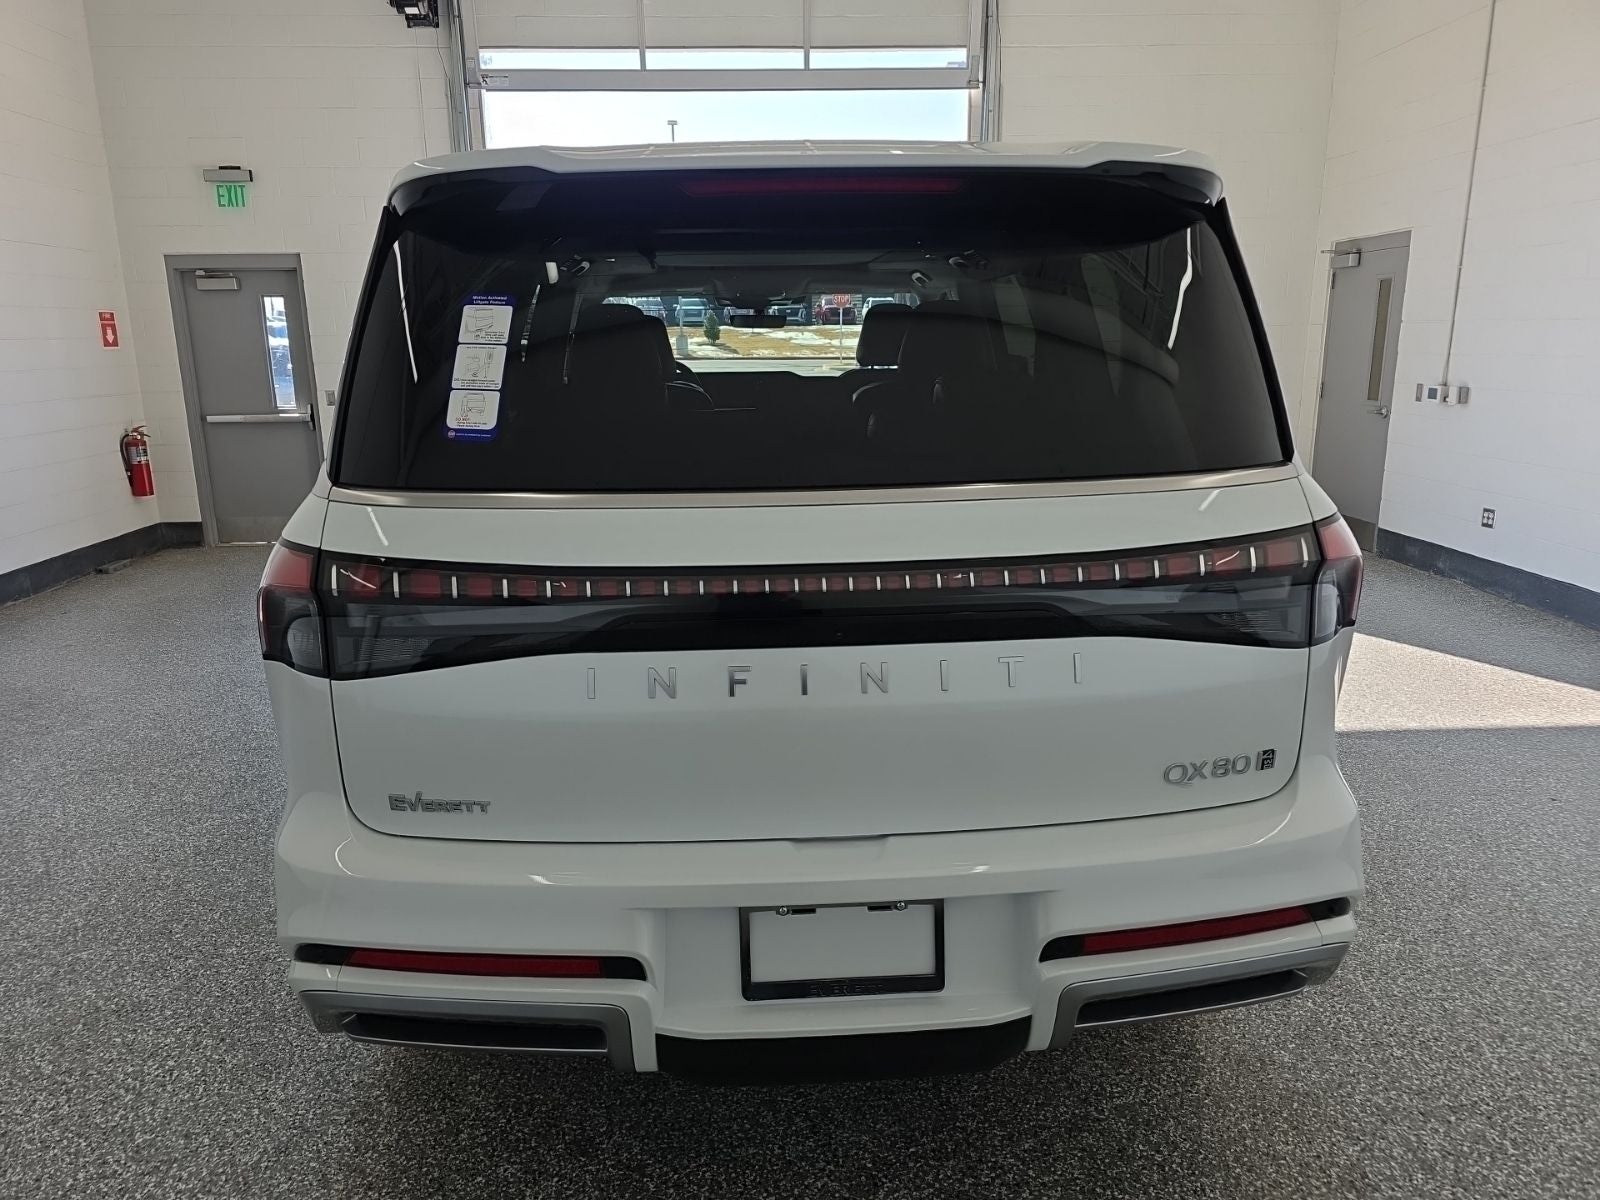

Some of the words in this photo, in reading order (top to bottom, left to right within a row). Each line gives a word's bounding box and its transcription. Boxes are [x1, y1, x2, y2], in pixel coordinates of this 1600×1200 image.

[216, 184, 246, 208] EXIT
[834, 295, 849, 303] STOP
[586, 652, 1083, 700] INFINITI
[1163, 753, 1252, 787] QX80
